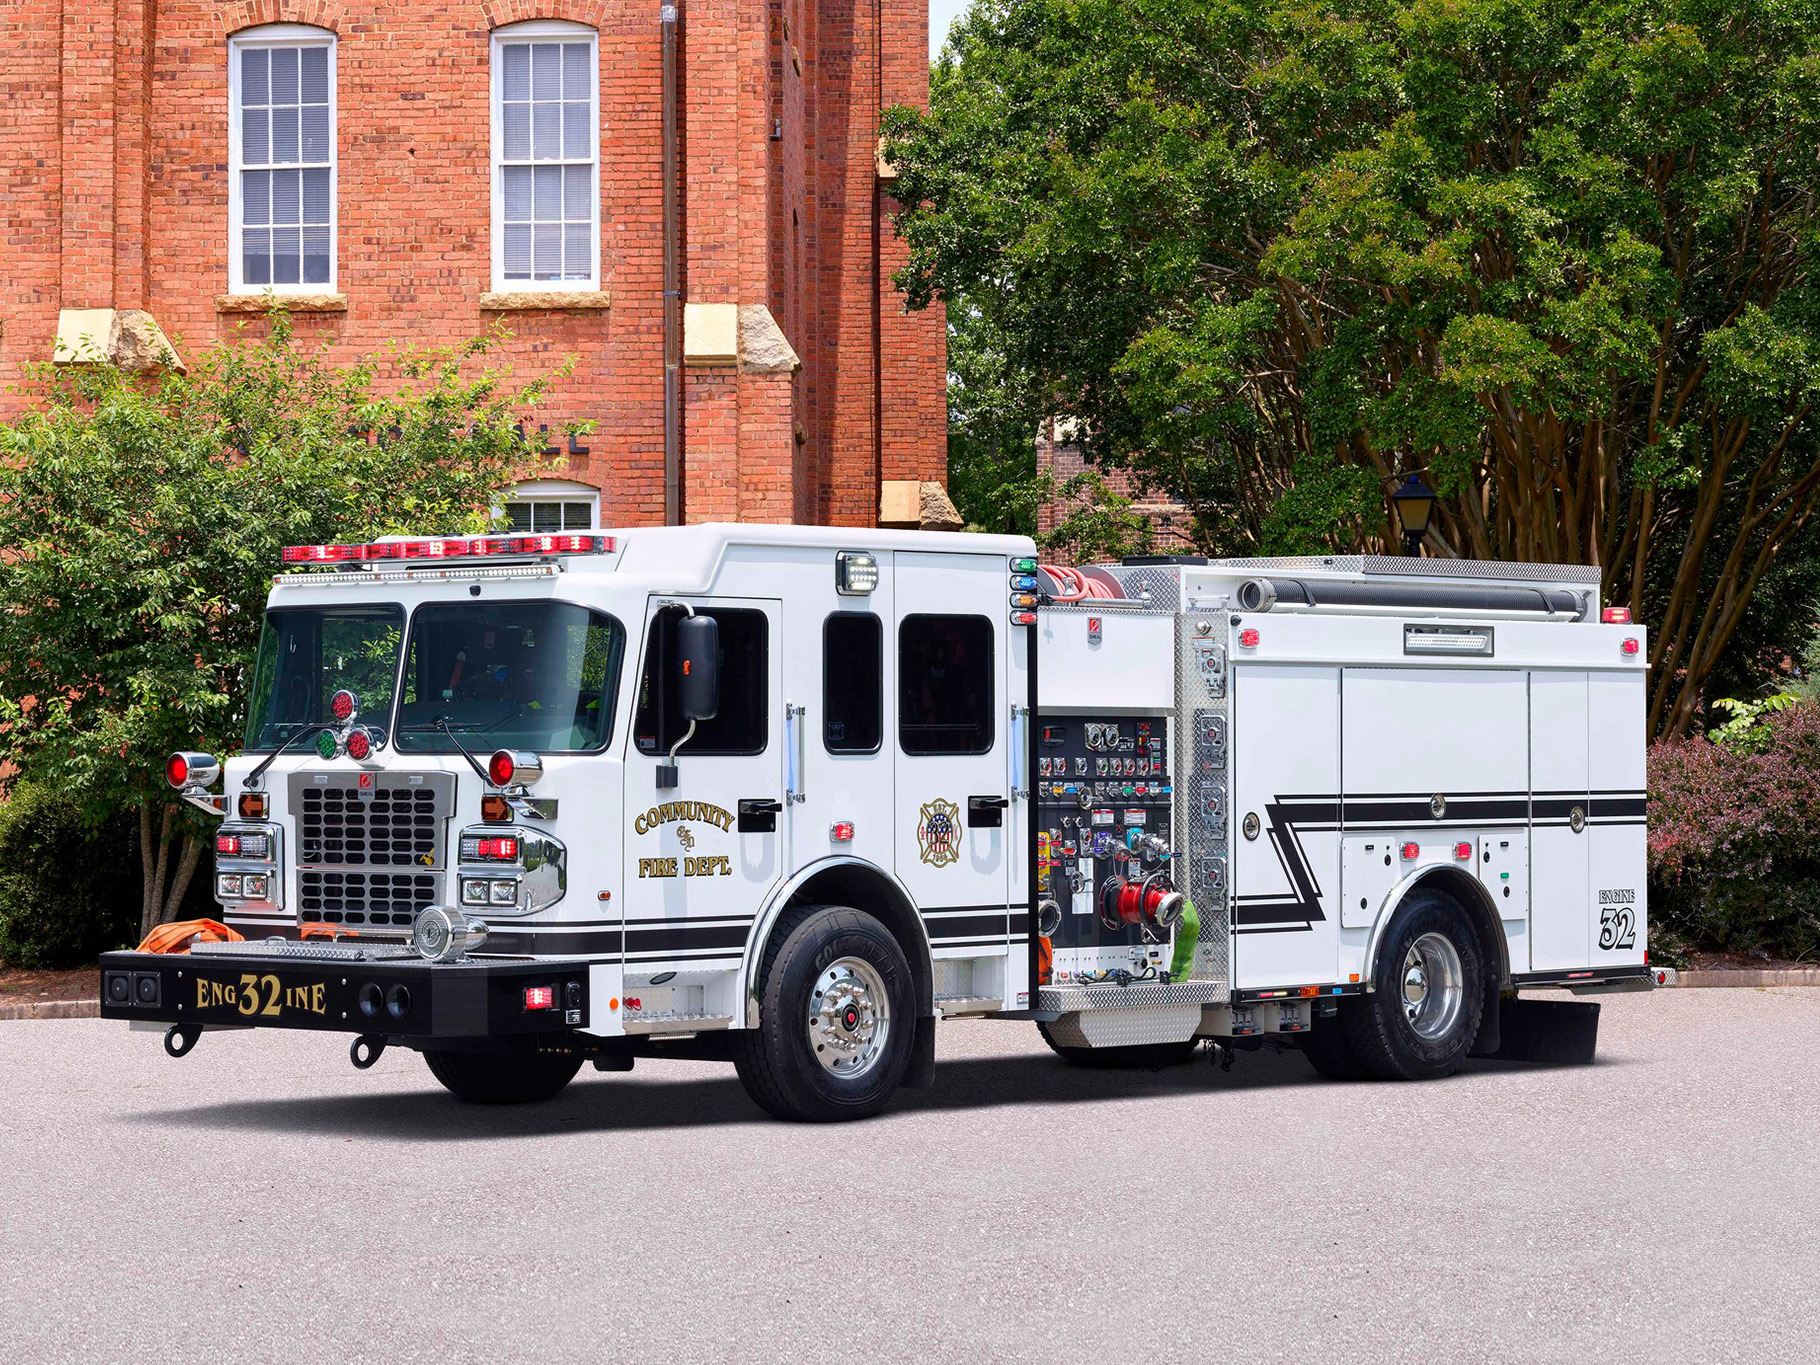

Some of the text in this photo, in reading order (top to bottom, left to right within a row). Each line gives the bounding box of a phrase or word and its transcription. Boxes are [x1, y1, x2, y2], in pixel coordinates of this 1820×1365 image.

[635, 800, 736, 836] COMMUNITY
[930, 821, 949, 845] 32
[638, 855, 732, 878] FIRE DEPT.
[1598, 889, 1635, 904] ENGINE
[1598, 907, 1636, 950] 32
[196, 973, 327, 1016] ENG 32 INE
